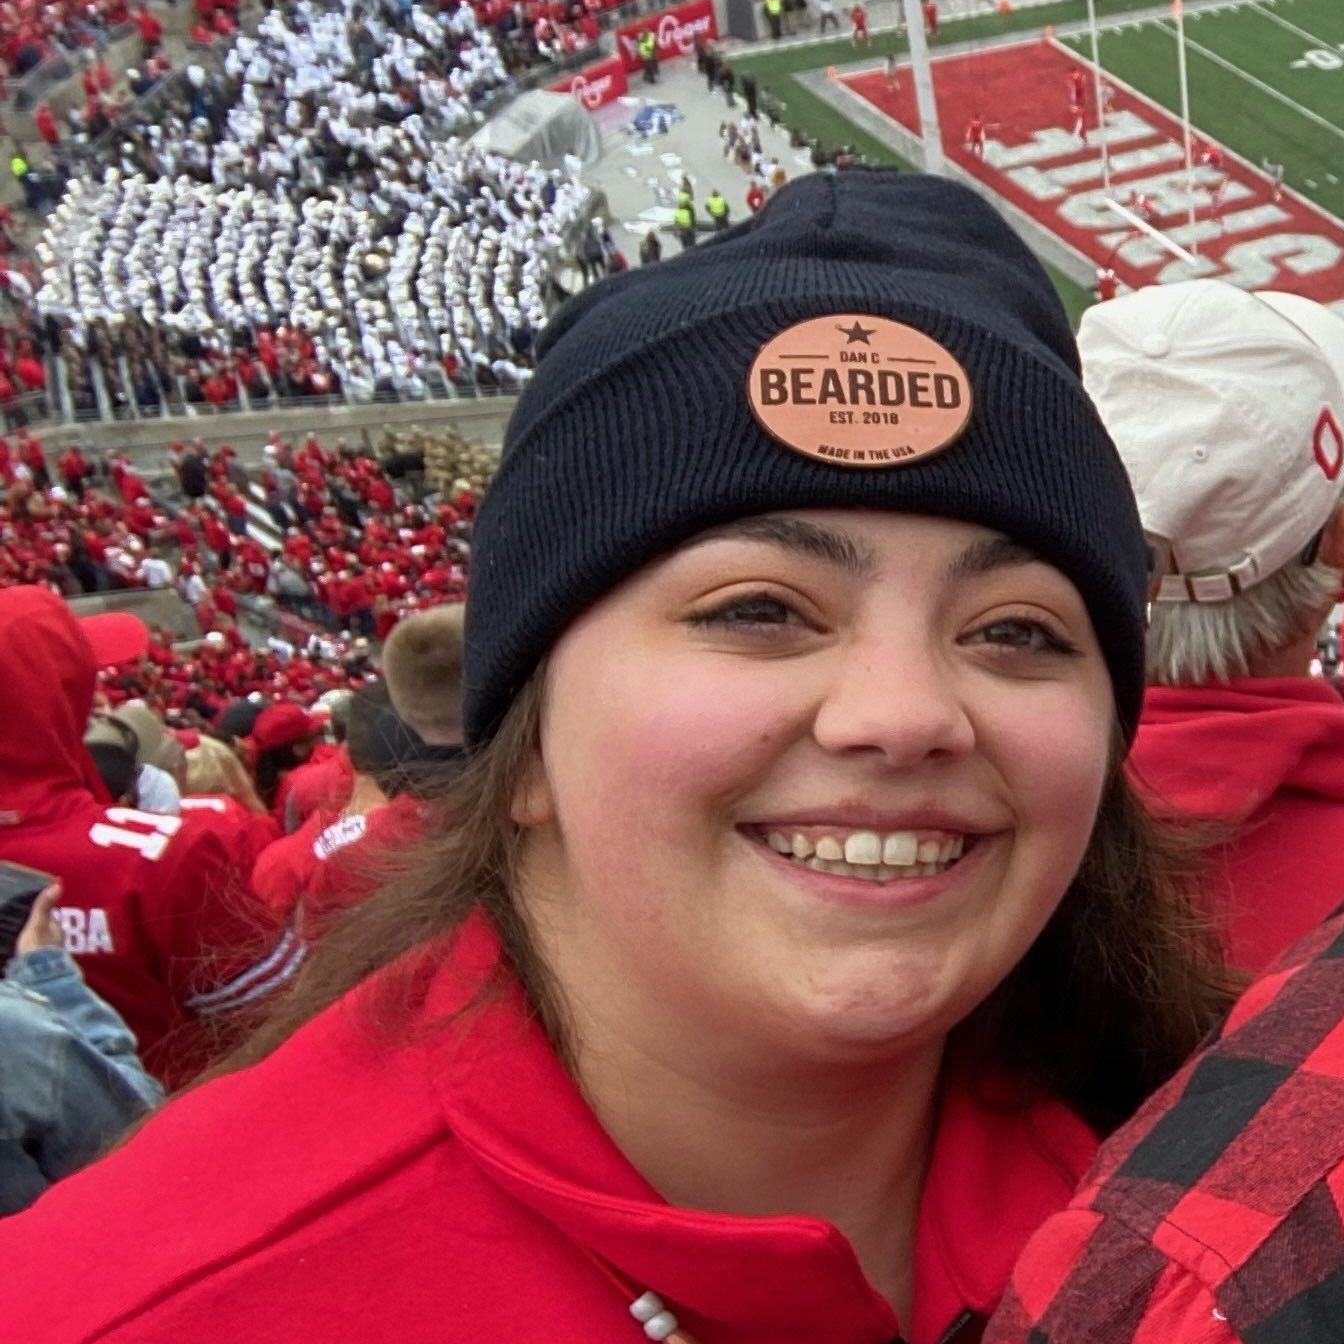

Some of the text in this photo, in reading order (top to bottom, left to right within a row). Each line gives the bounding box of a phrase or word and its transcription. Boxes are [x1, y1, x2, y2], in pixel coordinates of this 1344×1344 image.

[840, 351, 867, 363] DAN
[760, 367, 961, 409] BEARDED
[829, 411, 899, 425] EST. 2018
[817, 444, 915, 461] MADE IN THE USA
